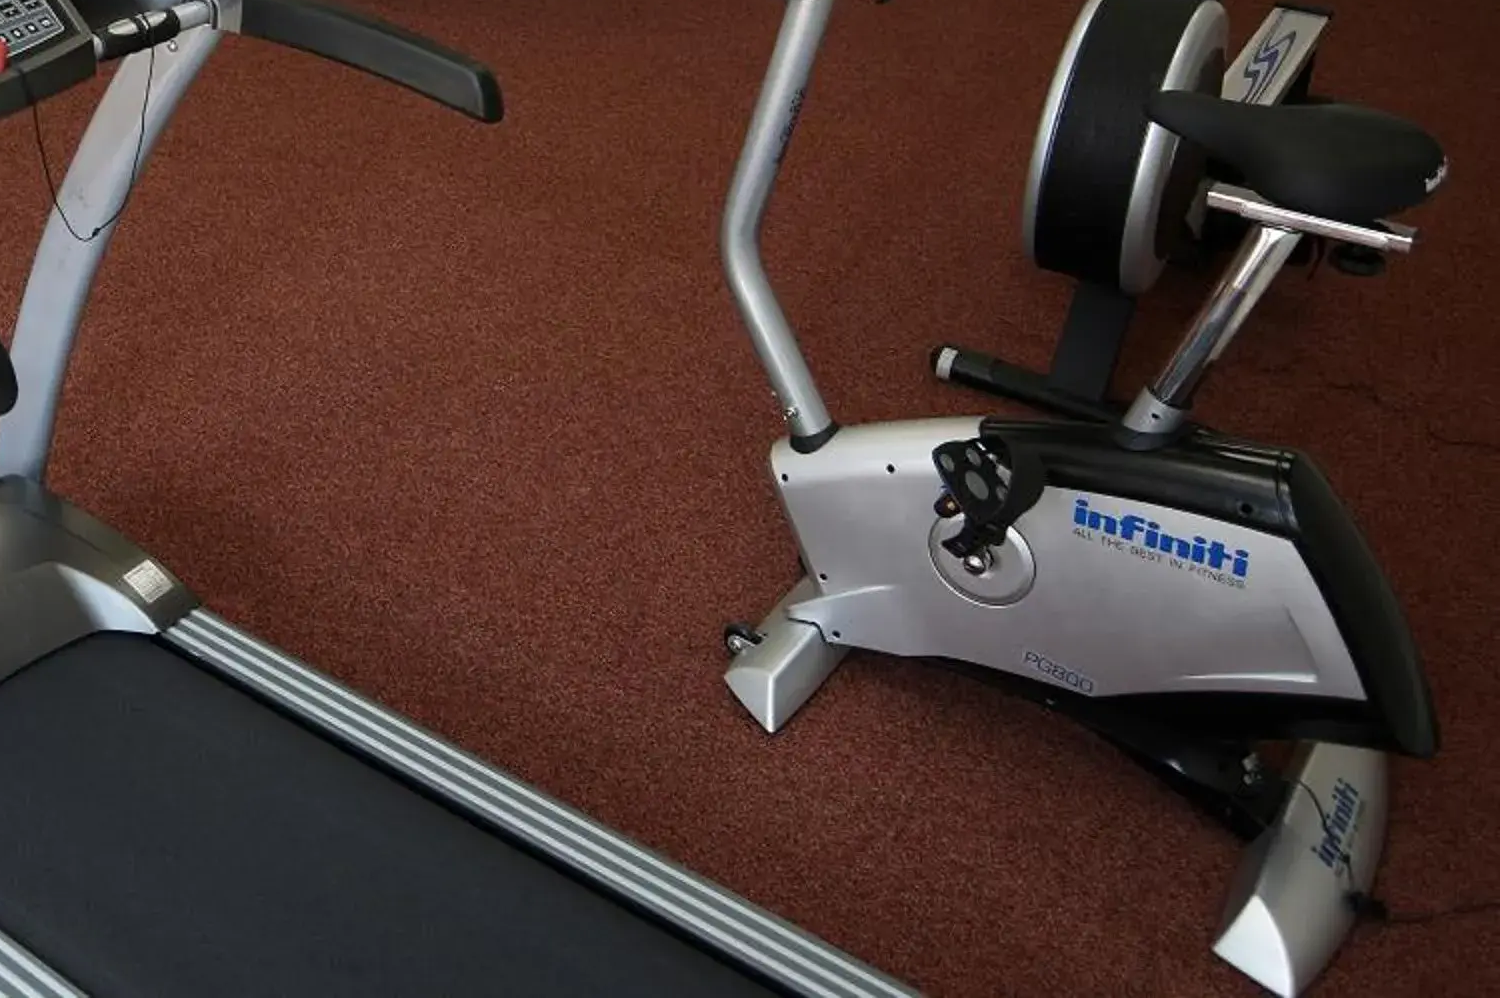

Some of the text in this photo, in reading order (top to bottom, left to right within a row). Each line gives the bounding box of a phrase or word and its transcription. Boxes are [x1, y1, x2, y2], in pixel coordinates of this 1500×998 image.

[1073, 499, 1249, 578] infiniti
[1074, 528, 1094, 541] ALL
[1100, 535, 1125, 552] THE
[1168, 556, 1184, 570] IN
[1188, 564, 1246, 588] FITNESS
[1310, 777, 1360, 869] infiniti
